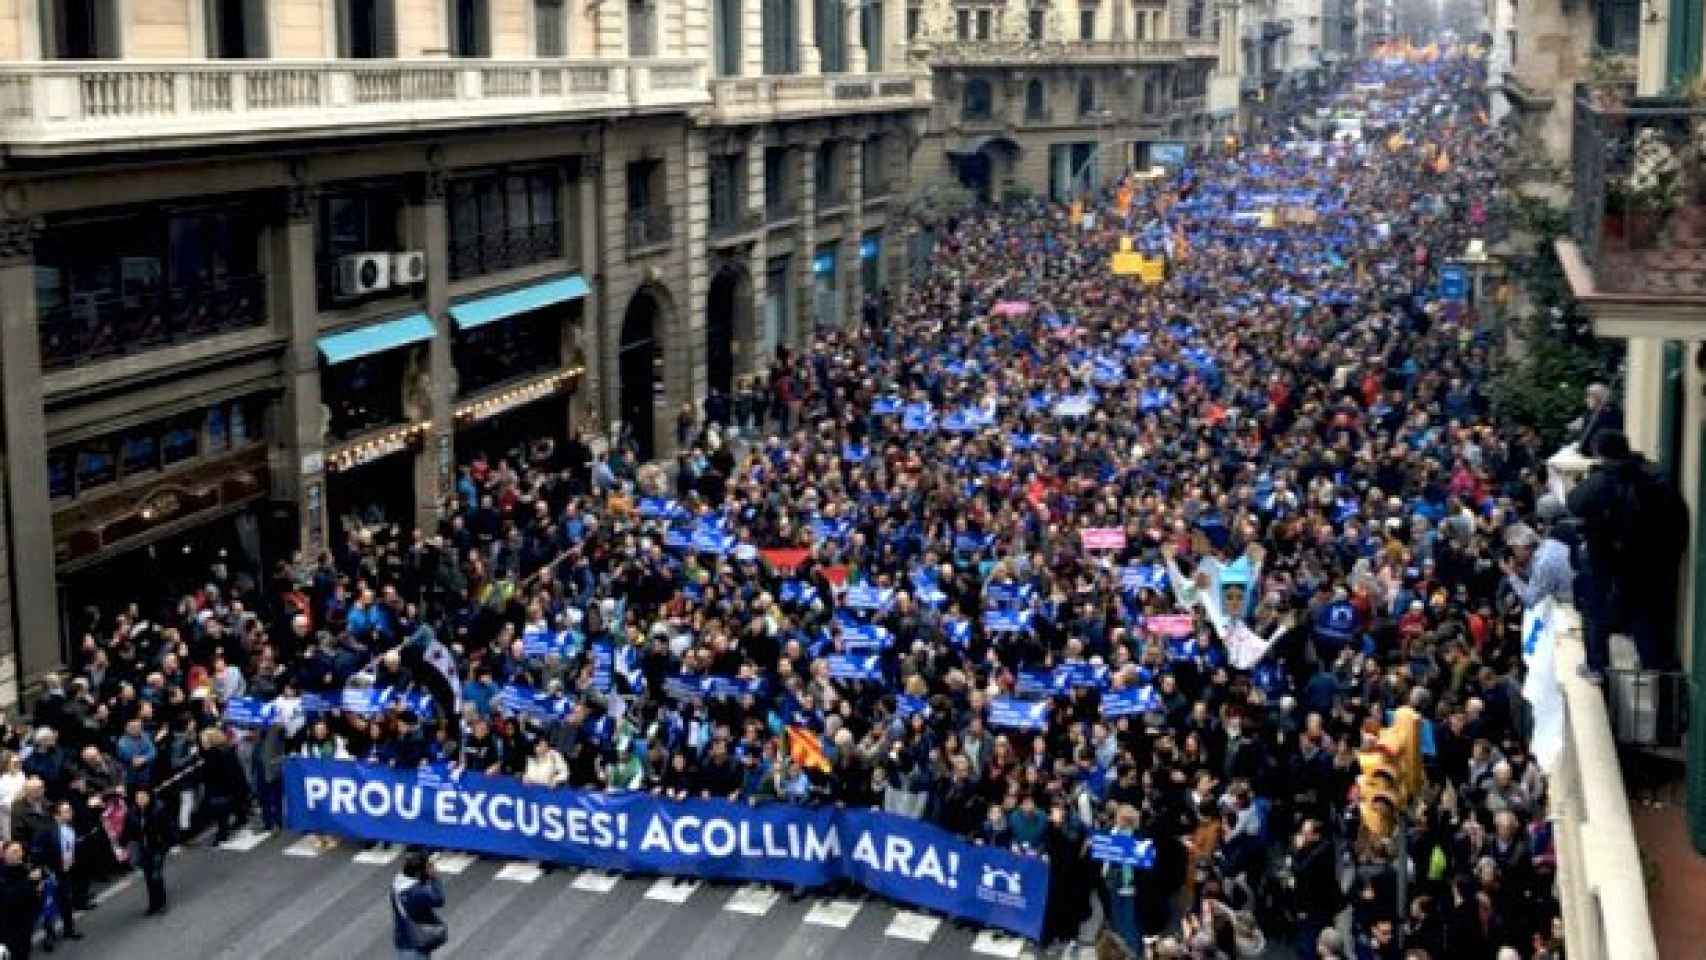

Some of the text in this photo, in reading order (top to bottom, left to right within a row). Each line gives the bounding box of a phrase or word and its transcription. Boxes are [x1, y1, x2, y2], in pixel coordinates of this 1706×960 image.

[304, 777, 961, 889] PROU EXCUSES! ACOLLIM ARA!
